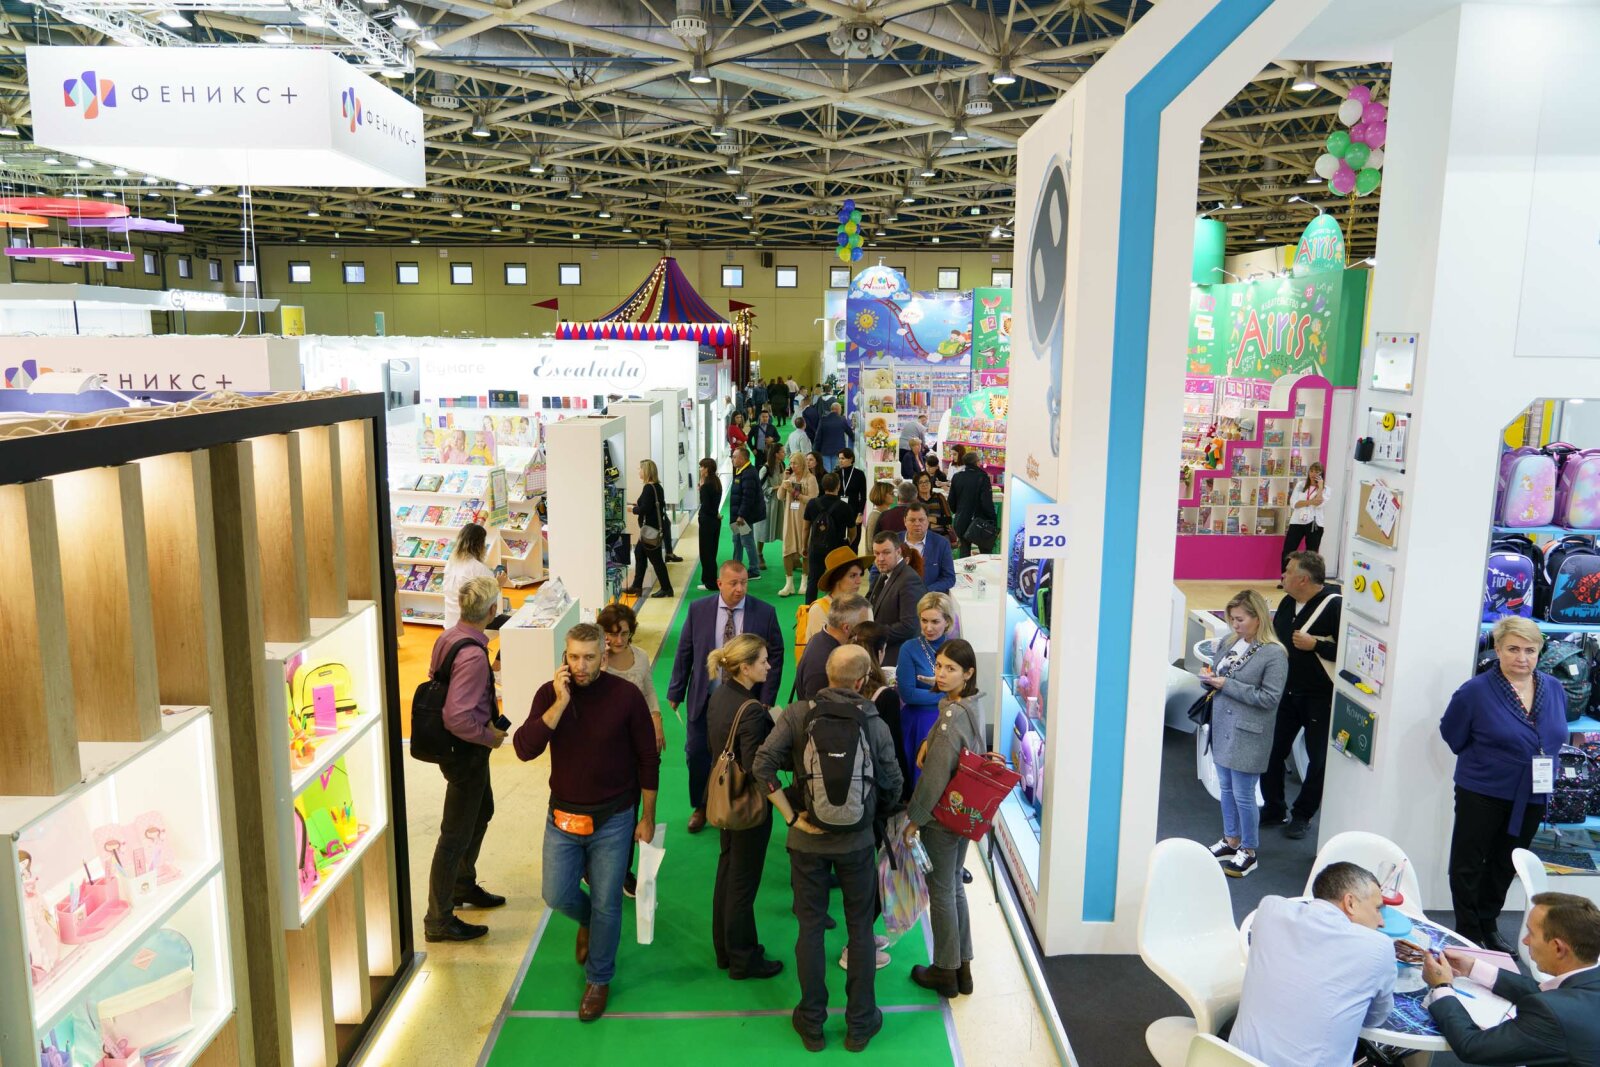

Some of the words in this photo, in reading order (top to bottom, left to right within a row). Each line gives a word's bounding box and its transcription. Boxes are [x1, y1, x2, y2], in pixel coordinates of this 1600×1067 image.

[131, 84, 298, 105] ФЕНИКС+
[366, 109, 417, 147] ФЕНИКС+
[1295, 236, 1338, 264] Airis
[1234, 308, 1311, 368] Airis
[533, 354, 640, 378] Escalada
[1036, 514, 1060, 526] 23
[1029, 535, 1066, 547] D20
